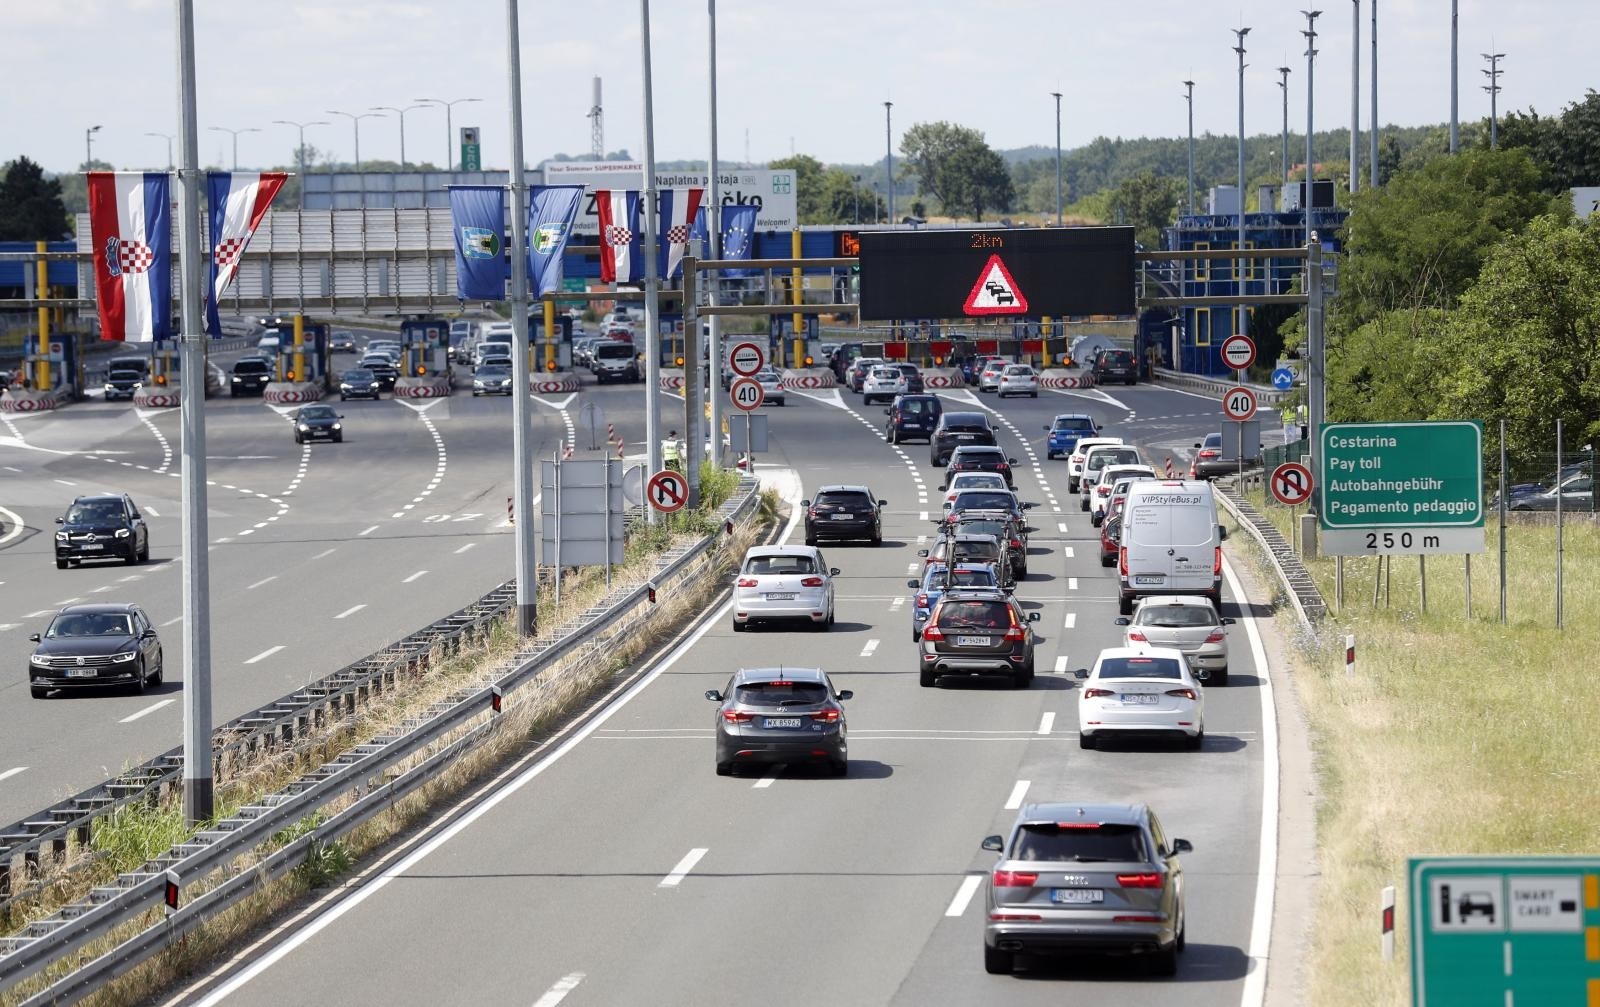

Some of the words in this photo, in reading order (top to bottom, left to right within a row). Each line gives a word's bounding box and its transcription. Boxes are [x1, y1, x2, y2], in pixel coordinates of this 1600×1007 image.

[655, 175, 698, 187] Naplatna
[757, 218, 791, 227] Welcome!
[971, 233, 1003, 248] 2km
[738, 386, 757, 402] 40
[1230, 396, 1250, 412] 40
[1329, 435, 1397, 448] Cestarina
[1330, 457, 1356, 472] Pay
[1360, 457, 1381, 469] toll
[1330, 478, 1444, 493] Autobahngebühr
[1141, 495, 1202, 504] VIPStyleBus.pl
[1331, 501, 1409, 516] Pagamento
[1413, 499, 1476, 515] pedaggio
[1365, 532, 1413, 548] 250
[1423, 535, 1439, 548] m
[1514, 889, 1555, 900] SMART
[1518, 905, 1552, 917] CARD
